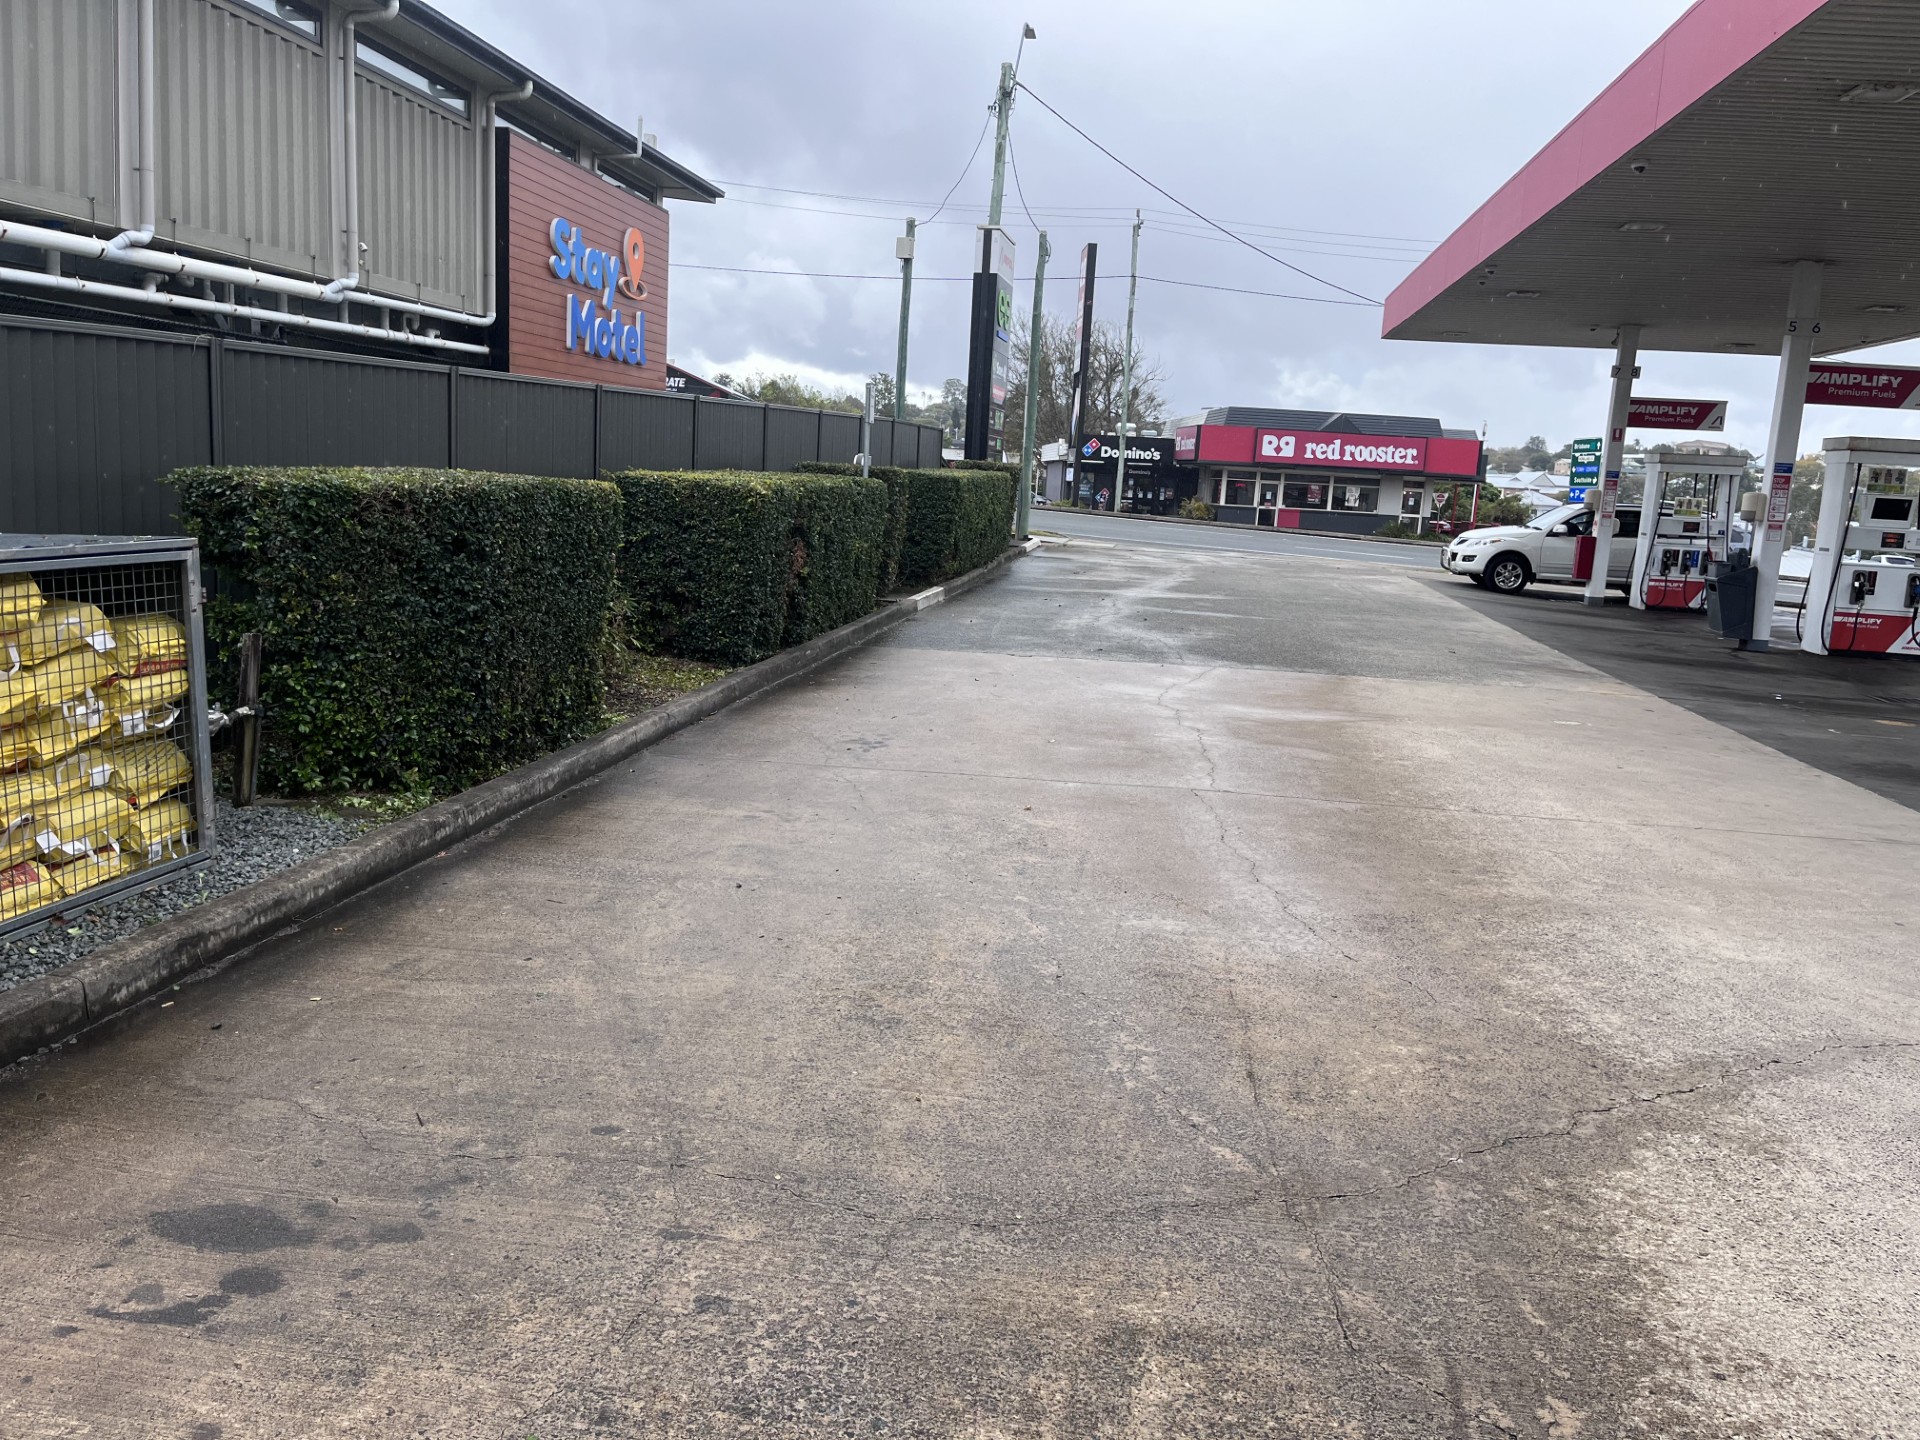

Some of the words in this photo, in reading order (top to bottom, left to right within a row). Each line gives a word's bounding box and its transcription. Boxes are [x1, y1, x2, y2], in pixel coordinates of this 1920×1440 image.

[549, 217, 620, 310] Stay
[566, 293, 646, 366] Motel
[1788, 320, 1797, 332] 5
[1812, 322, 1821, 334] 6
[1614, 367, 1621, 376] 7
[1630, 368, 1638, 377] 8
[1816, 372, 1903, 388] AMPLIFY
[1828, 386, 1870, 397] Premium
[1872, 389, 1896, 399] Fuels
[1635, 404, 1699, 416] AMPLIFY
[1644, 415, 1675, 423] Premium
[1676, 416, 1694, 424] Fuels
[1304, 439, 1341, 460] red
[1343, 445, 1417, 465] rooster
[1574, 490, 1580, 498] P
[1841, 616, 1882, 625] AMPLIFY
